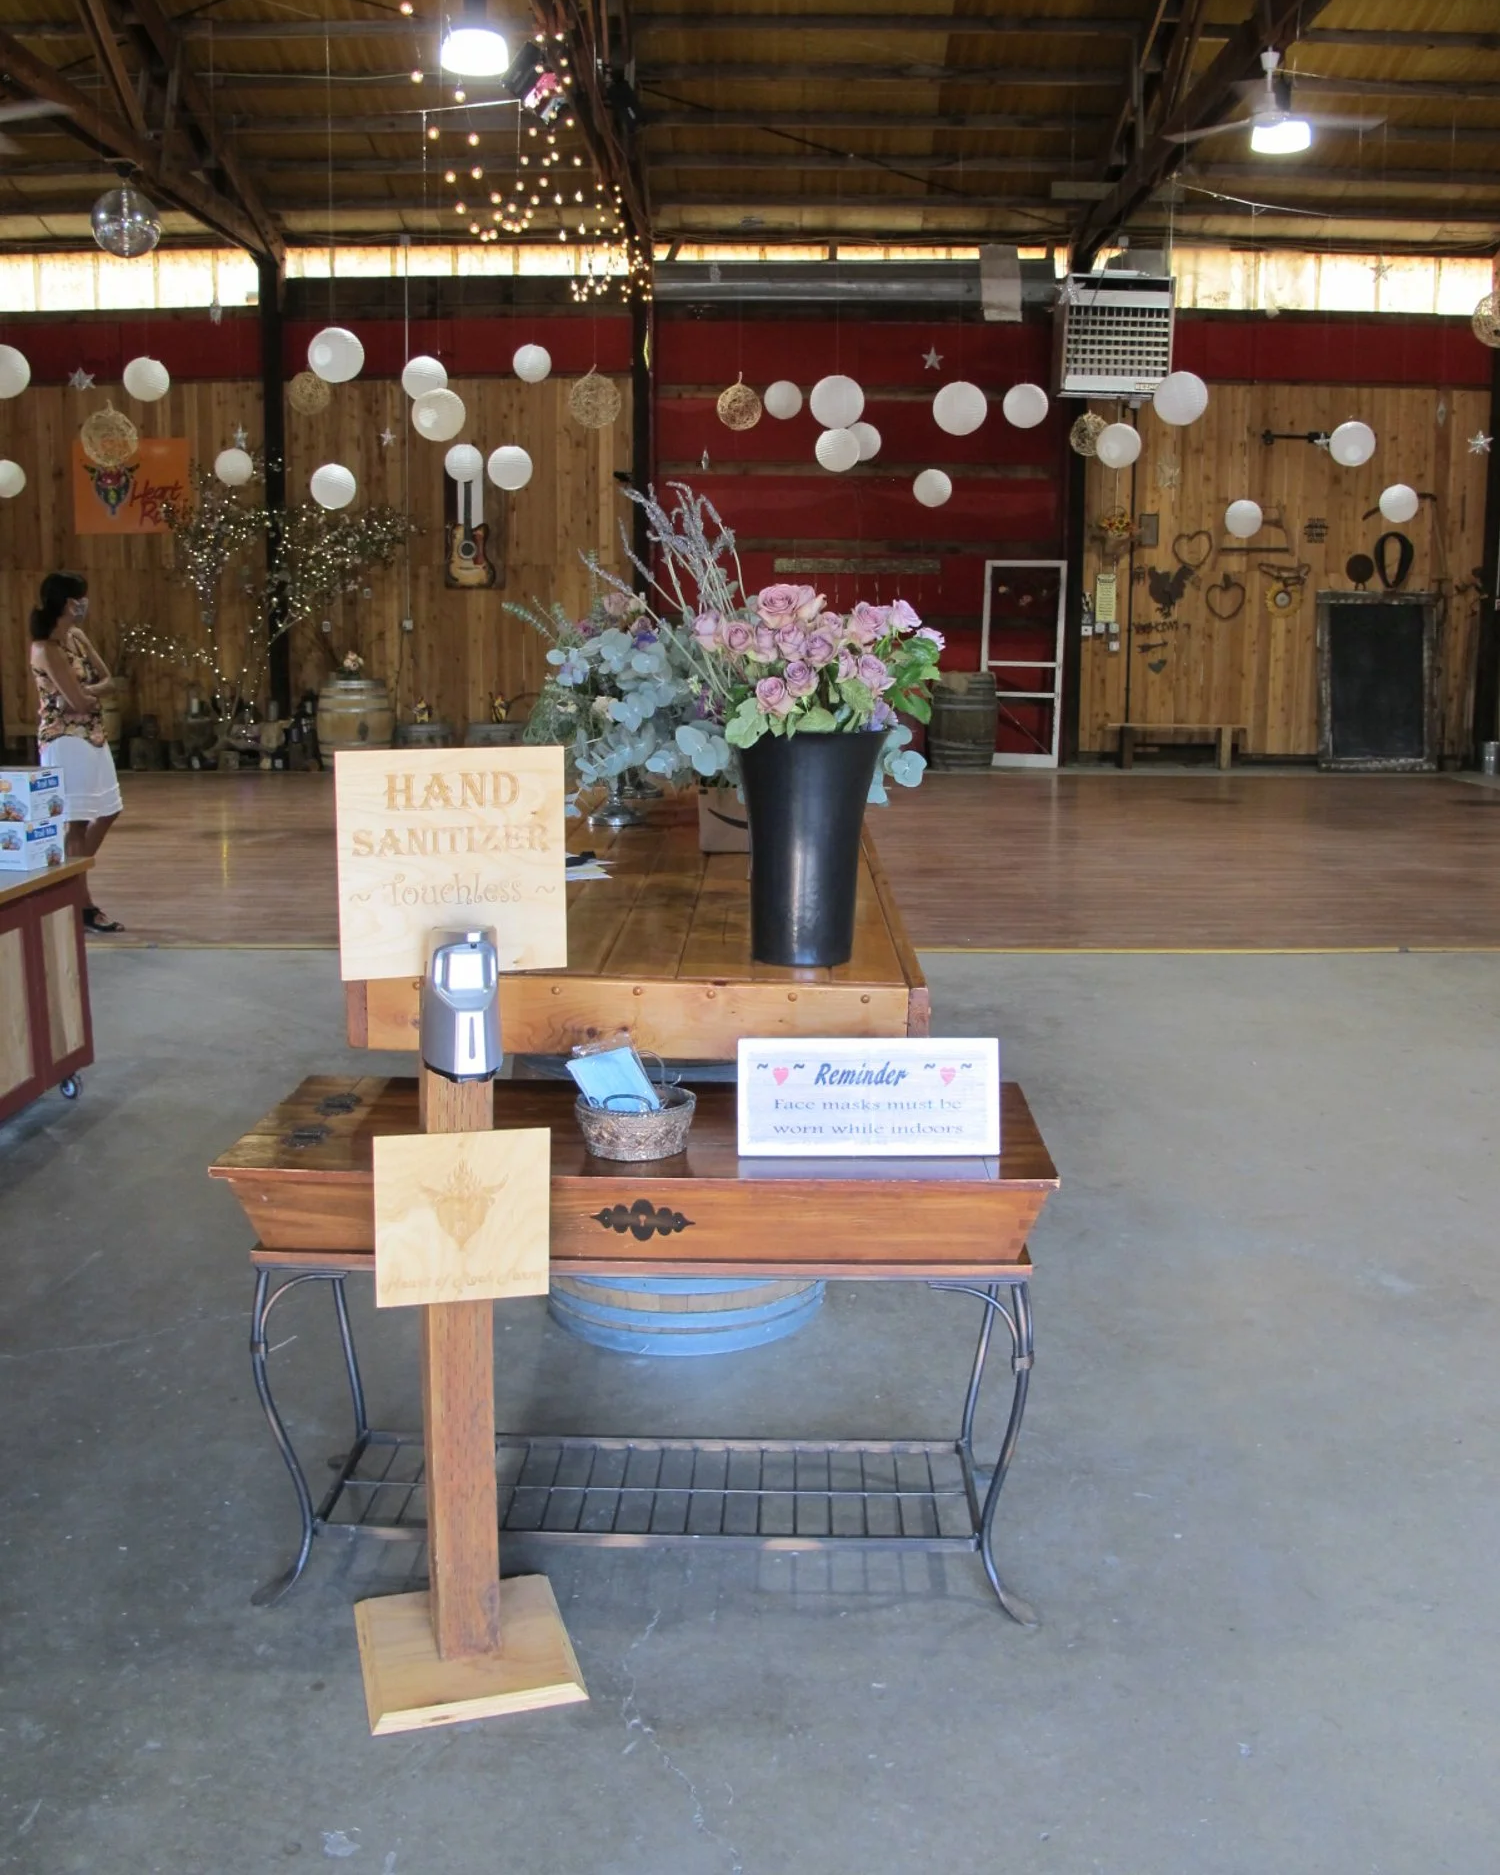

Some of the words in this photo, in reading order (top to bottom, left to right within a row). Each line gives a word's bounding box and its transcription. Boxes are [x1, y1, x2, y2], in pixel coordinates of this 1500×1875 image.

[129, 479, 184, 507] Heart
[383, 771, 521, 812] HAND
[351, 824, 552, 858] SANITIZER
[382, 873, 522, 907] Touchless
[814, 1061, 909, 1087] Reminder
[774, 1098, 816, 1110] Face
[823, 1098, 881, 1110] masks
[887, 1099, 933, 1110] must
[938, 1098, 962, 1110] be
[773, 1124, 823, 1135] worn
[831, 1122, 884, 1135] while
[891, 1122, 963, 1135] indoors
